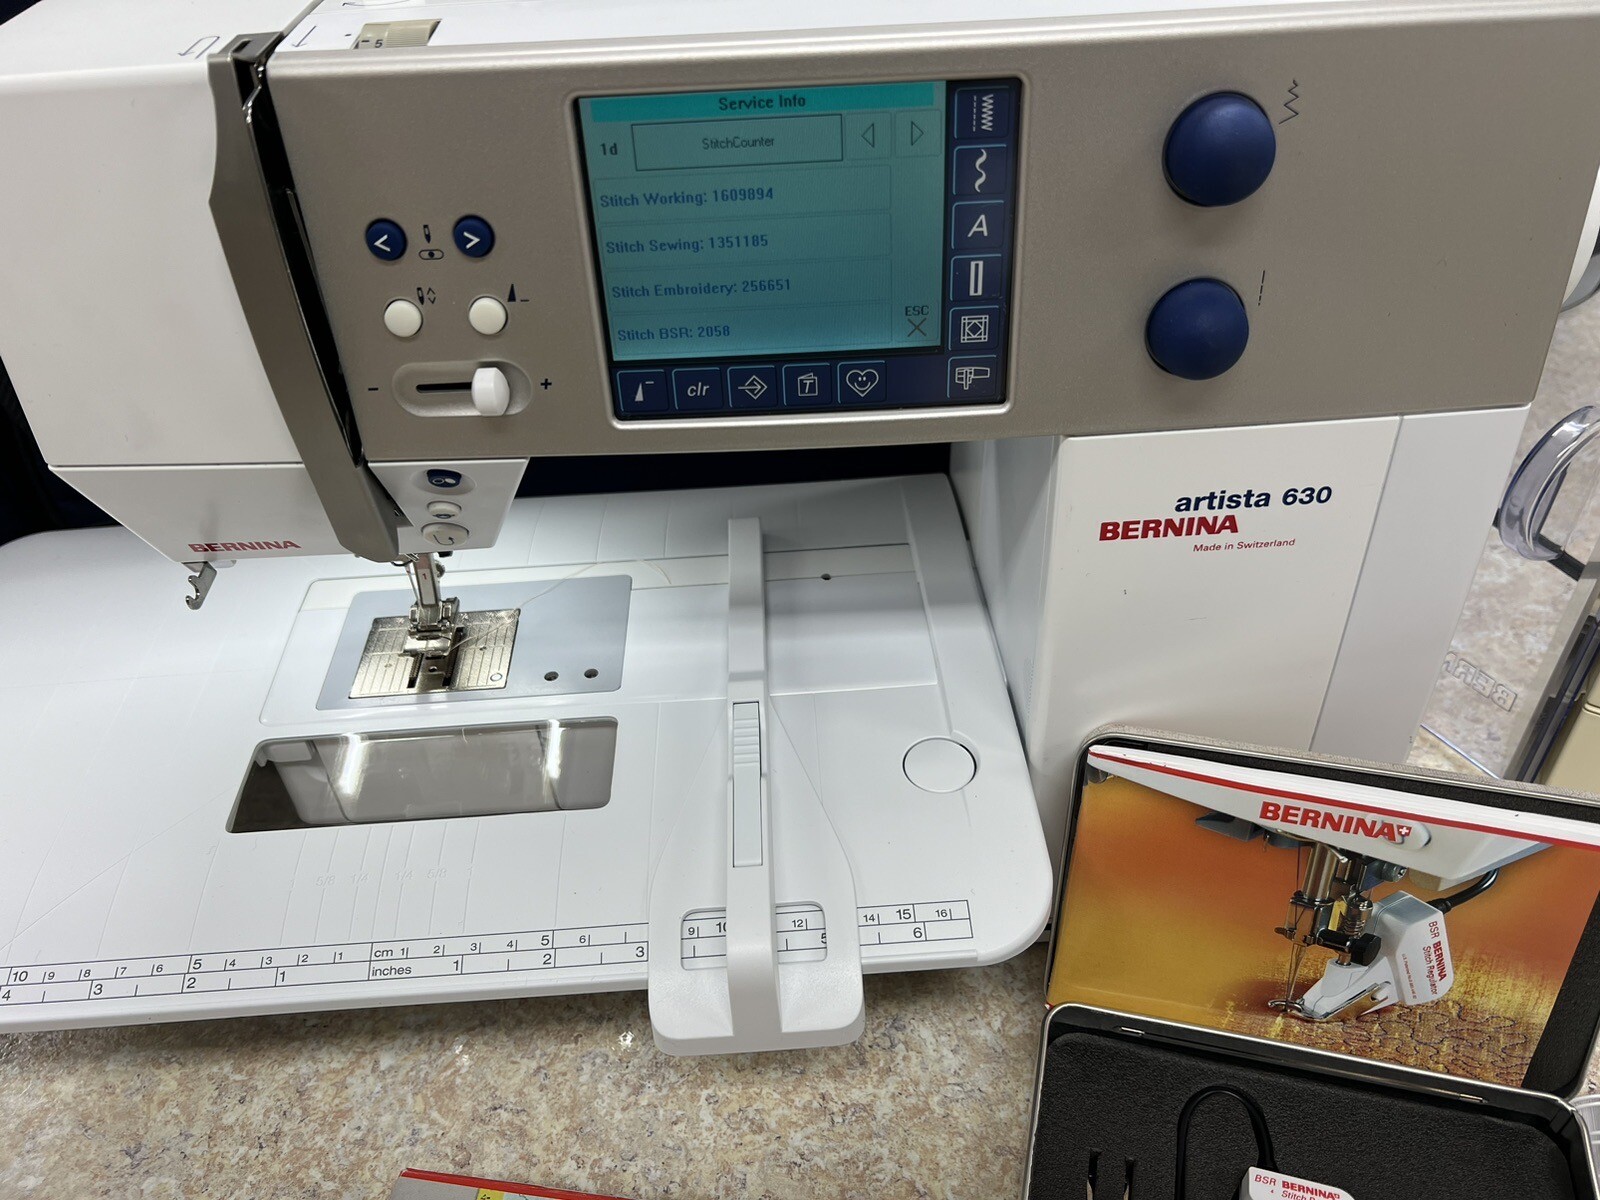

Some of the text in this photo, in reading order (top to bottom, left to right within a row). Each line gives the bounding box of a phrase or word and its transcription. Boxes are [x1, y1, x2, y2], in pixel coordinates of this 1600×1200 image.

[375, 39, 383, 48] 5
[718, 94, 806, 111] Service Info
[701, 136, 775, 150] StitchCounter
[600, 194, 639, 208] Stitch
[643, 191, 707, 207] Working:
[967, 214, 988, 237] A
[606, 234, 768, 254] Stitch Sewing: 1351185
[612, 278, 791, 299] Stitch Embroidery: 256651
[904, 305, 930, 317] ESC
[617, 325, 731, 341] Stitch BSR: 2058
[687, 382, 710, 397] clr
[1174, 486, 1333, 513] artista 630
[1099, 514, 1239, 541] BERNINA
[188, 540, 302, 554] BERNINA
[1193, 538, 1296, 553] Made in Switzerland
[1259, 801, 1398, 842] BERNINA
[12, 970, 28, 983] 10
[47, 971, 55, 981] 9
[83, 968, 91, 978] 8
[120, 966, 127, 976] 7
[155, 964, 163, 973] 6
[192, 958, 202, 970] 5
[229, 958, 236, 967] 4
[265, 956, 273, 965] 3
[301, 954, 309, 963] 2
[373, 948, 394, 958] cm
[433, 945, 440, 954] 2
[470, 942, 477, 952] 3
[506, 940, 514, 949] 4
[540, 934, 550, 946] 5
[579, 935, 587, 944] 6
[688, 926, 695, 936] 9
[716, 922, 726, 933] 1
[791, 919, 804, 928] 12
[863, 914, 875, 923] 14
[896, 908, 912, 921] 15
[935, 909, 948, 918] 16
[1422, 945, 1434, 966] Stitch
[1428, 920, 1448, 982] BSR BERNINA
[1, 989, 11, 1001] 4
[93, 983, 103, 995] 3
[186, 977, 196, 989] 2
[279, 971, 286, 982] 1
[371, 964, 412, 977] inches
[543, 953, 552, 965] 2
[635, 946, 645, 958] 3
[912, 926, 923, 939] 6
[1254, 1174, 1335, 1200] BSR BERNINA
